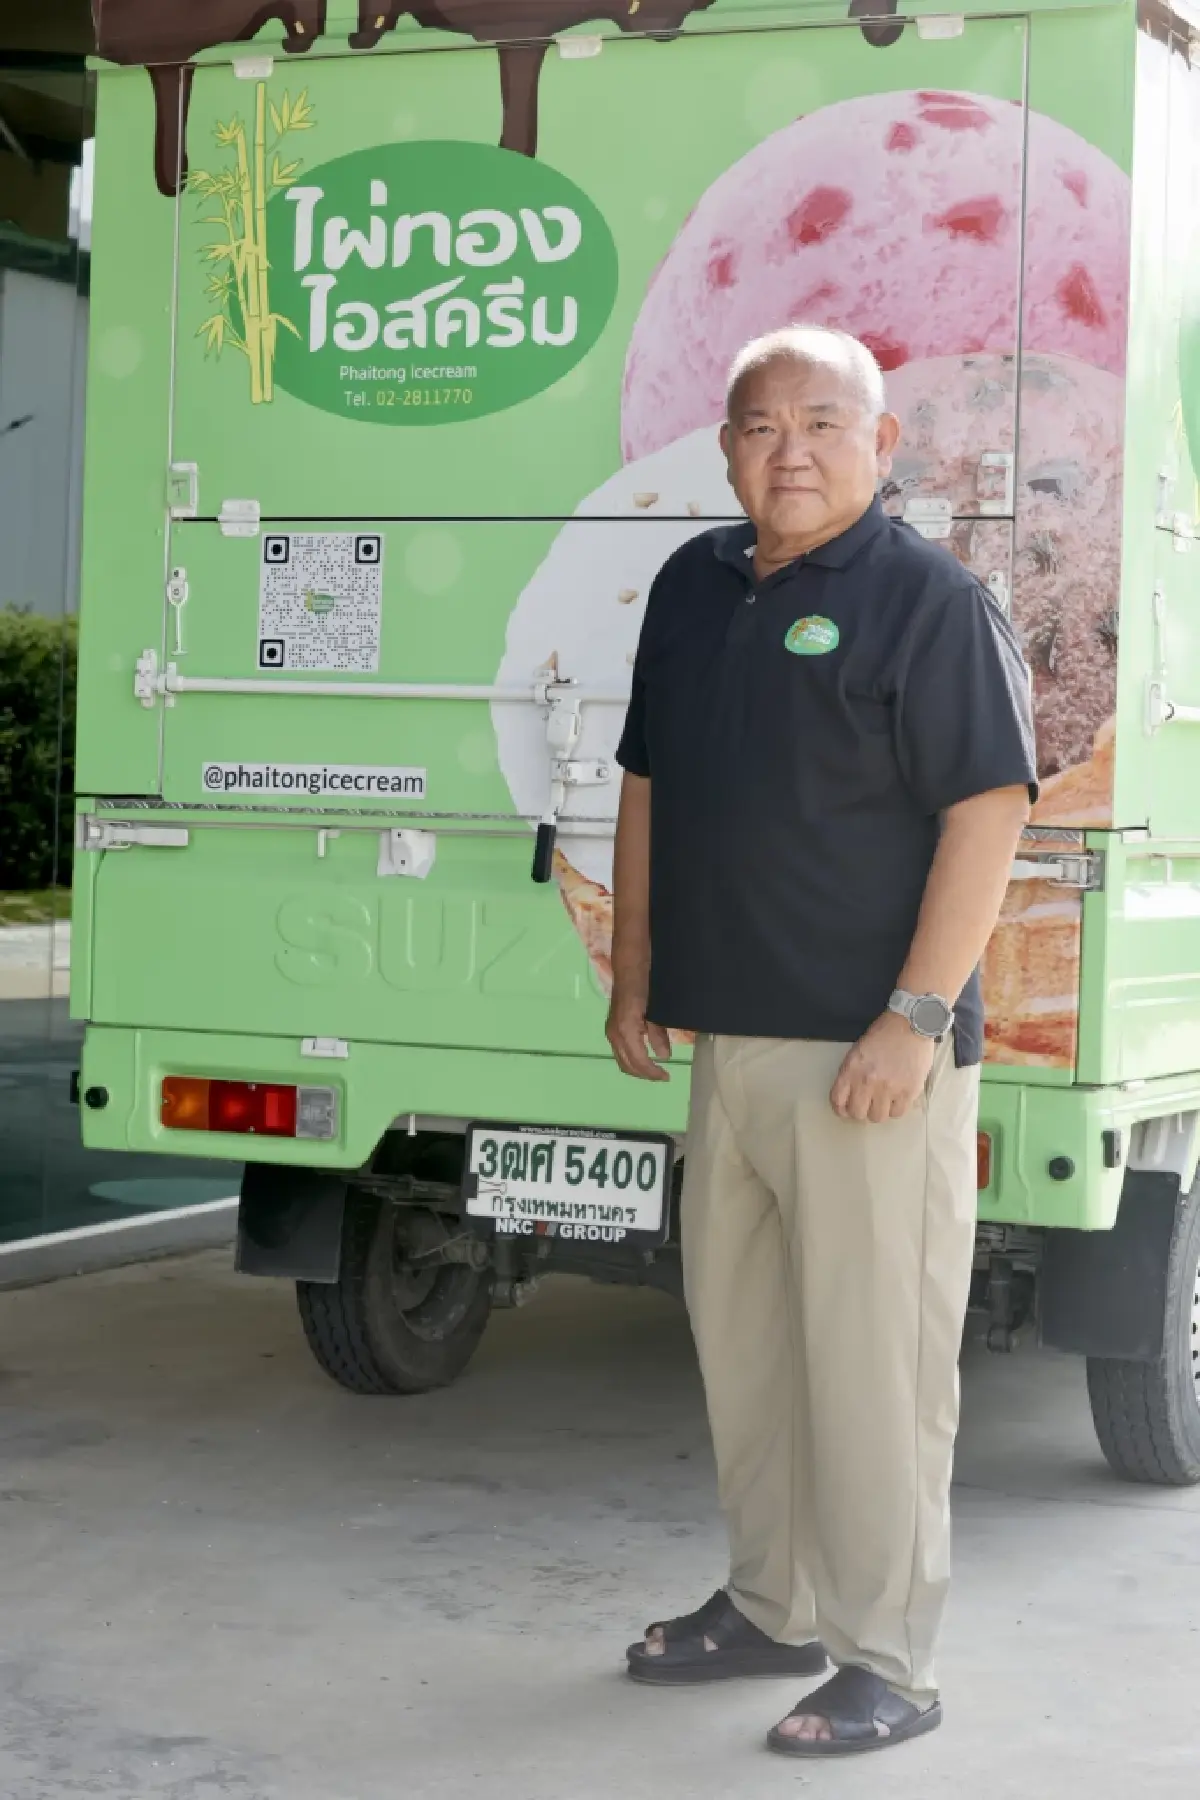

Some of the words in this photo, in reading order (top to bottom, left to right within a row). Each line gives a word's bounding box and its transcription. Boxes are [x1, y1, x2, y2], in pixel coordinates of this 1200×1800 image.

[285, 179, 582, 272] ไผ่ทอง
[300, 274, 578, 352] ไอสครีม
[339, 365, 406, 384] Phaitong
[344, 390, 371, 406] Tel.
[376, 388, 473, 406] 02-2811770
[204, 765, 423, 794] @phaitongicecream
[564, 1144, 657, 1192] 5400
[492, 1195, 638, 1224] กรุงเทพมหานคร
[495, 1218, 534, 1235] NKC
[559, 1224, 627, 1243] GROUP
